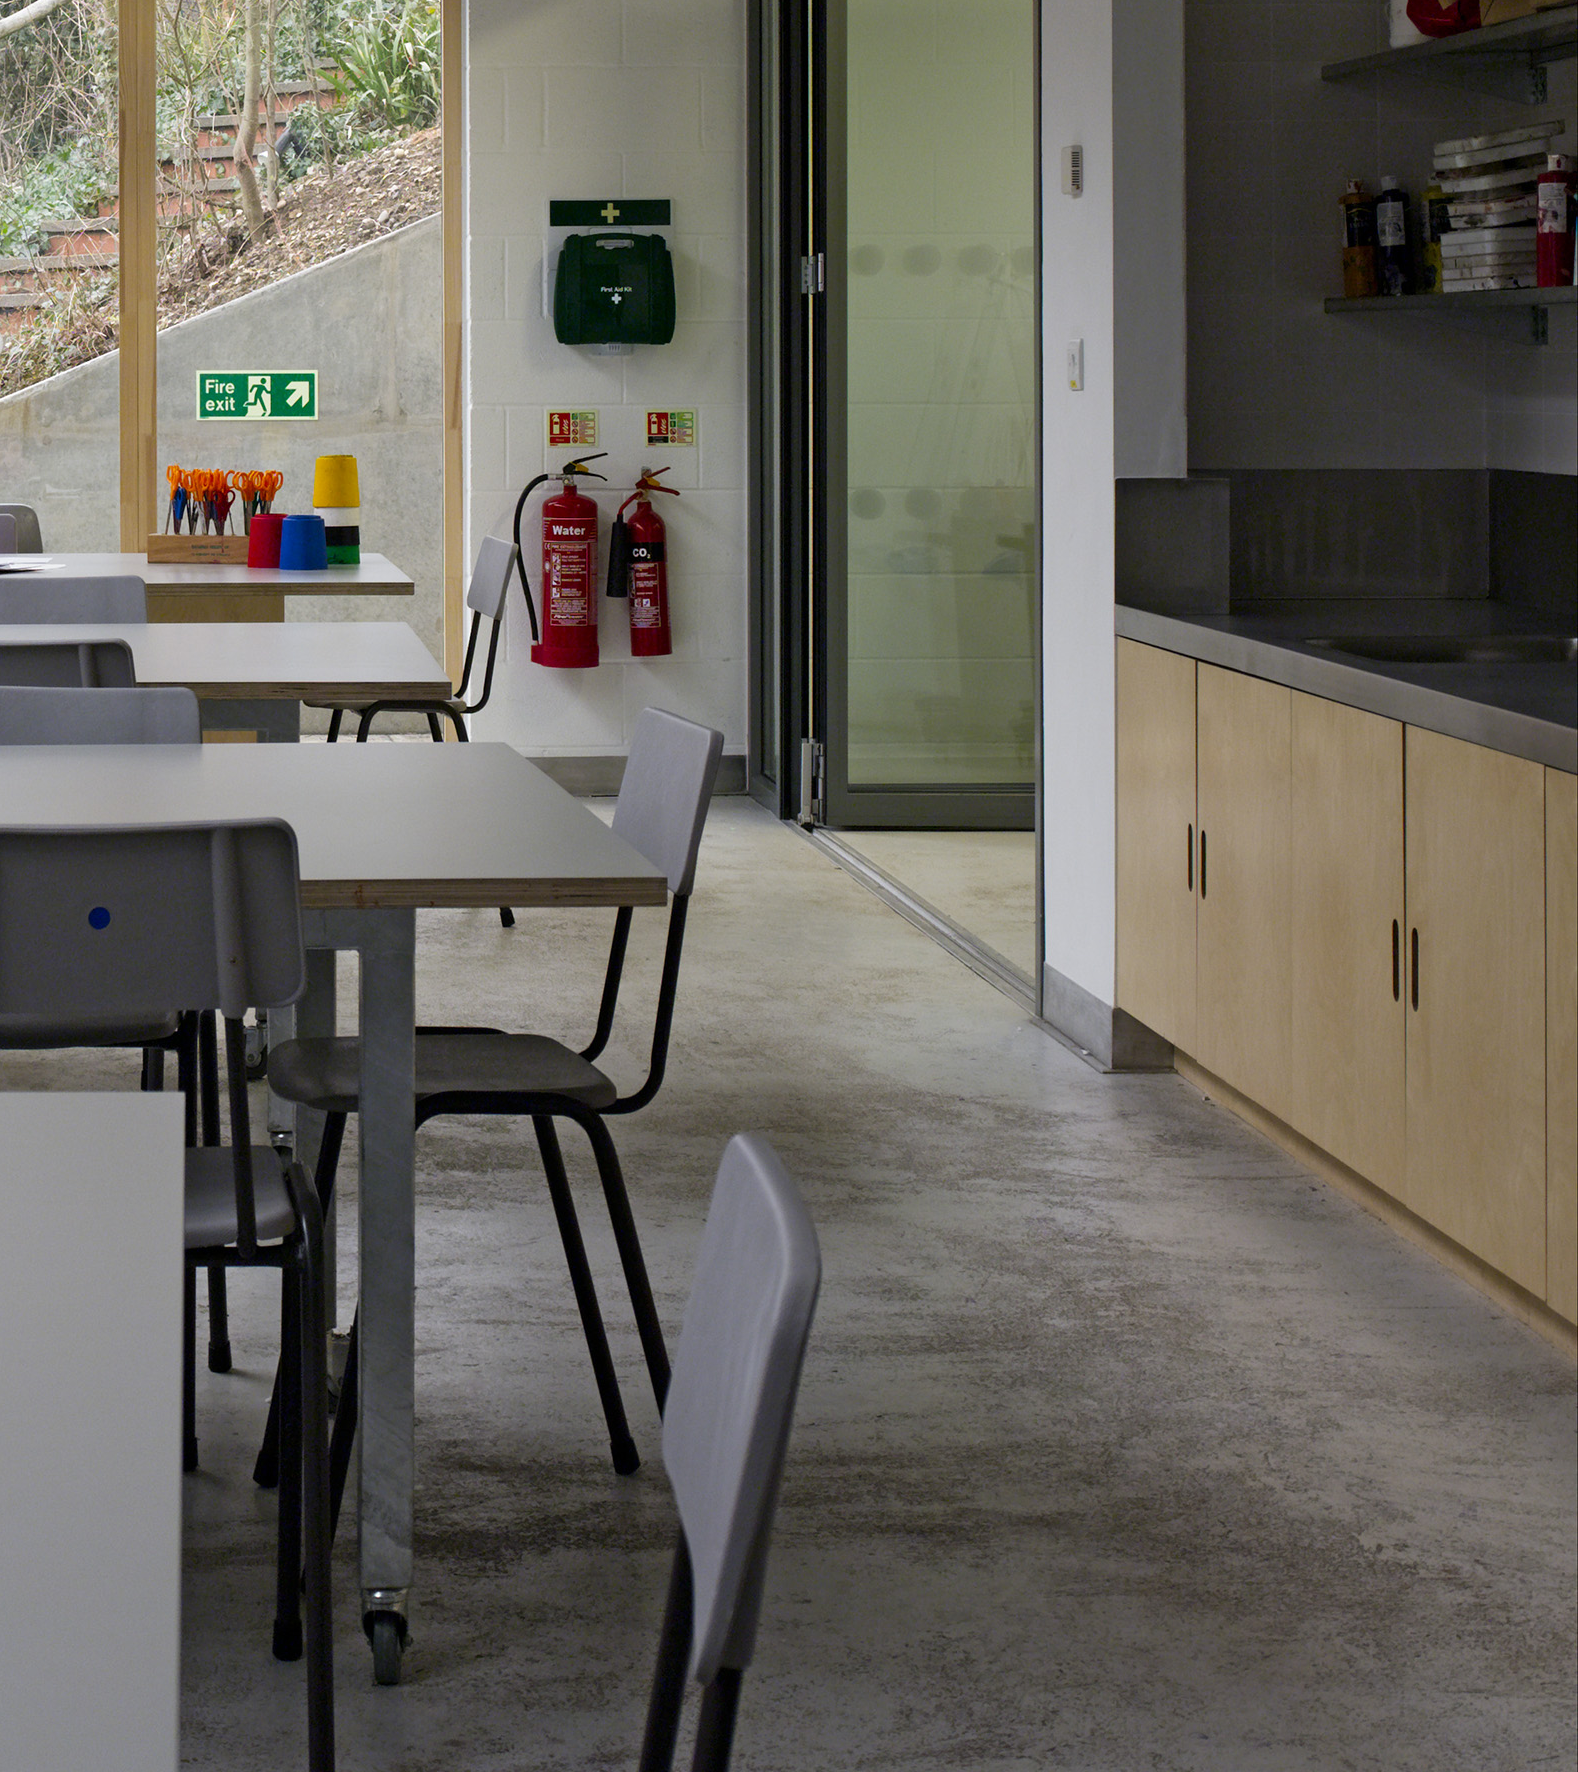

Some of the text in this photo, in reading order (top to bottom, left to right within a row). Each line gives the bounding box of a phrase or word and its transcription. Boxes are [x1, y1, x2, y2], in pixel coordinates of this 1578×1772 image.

[205, 379, 235, 395] Fire
[205, 397, 235, 412] exit
[552, 525, 586, 536] Water
